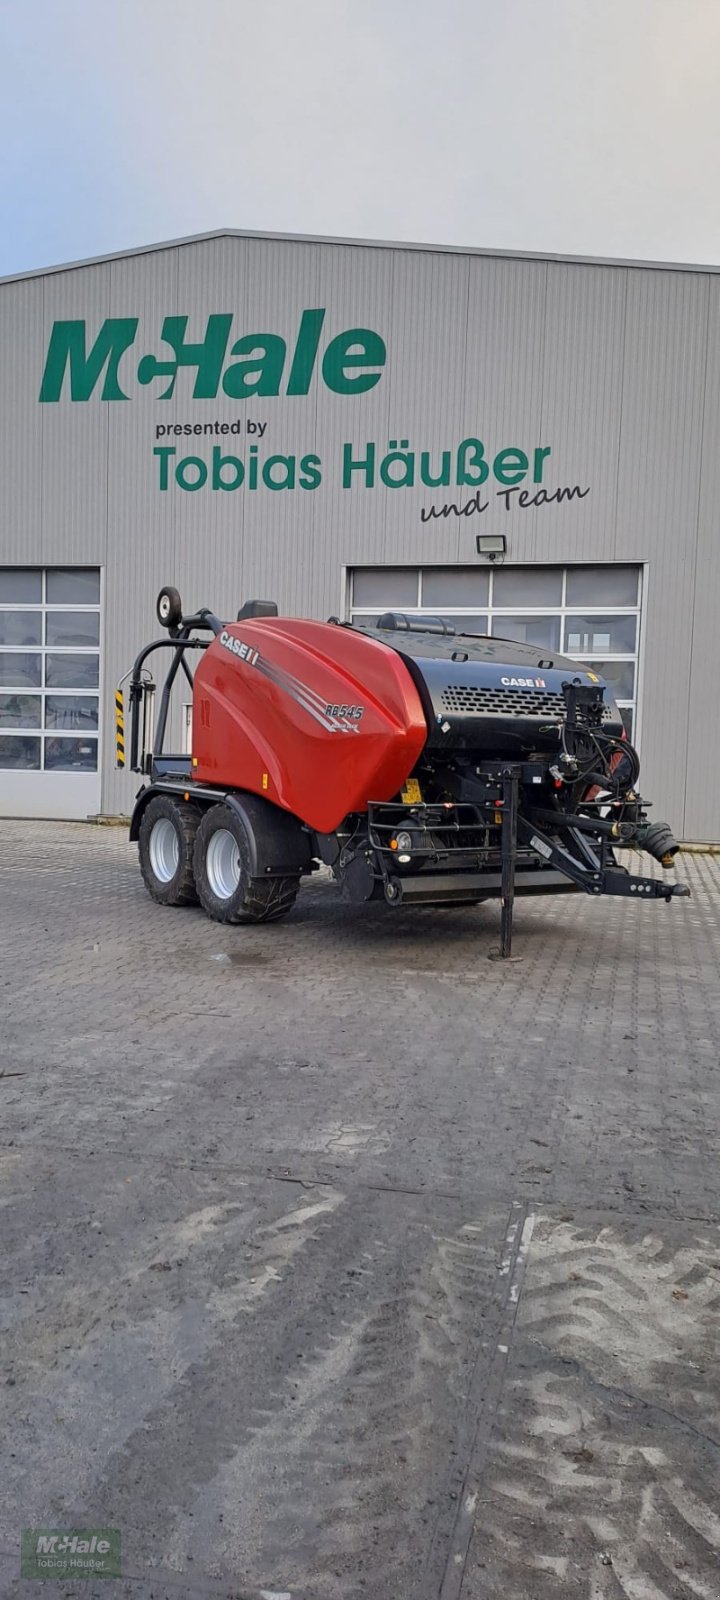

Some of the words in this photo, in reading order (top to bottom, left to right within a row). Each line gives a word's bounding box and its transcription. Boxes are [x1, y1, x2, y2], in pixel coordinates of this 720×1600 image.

[38, 308, 387, 403] McHale
[155, 420, 241, 439] presented
[246, 419, 268, 438] by
[153, 445, 322, 492] Tobias
[342, 437, 552, 489] Häußer
[420, 490, 489, 523] und
[496, 485, 591, 511] Team
[219, 630, 249, 660] CASE
[500, 677, 535, 688] CASE
[325, 703, 364, 720] RB545
